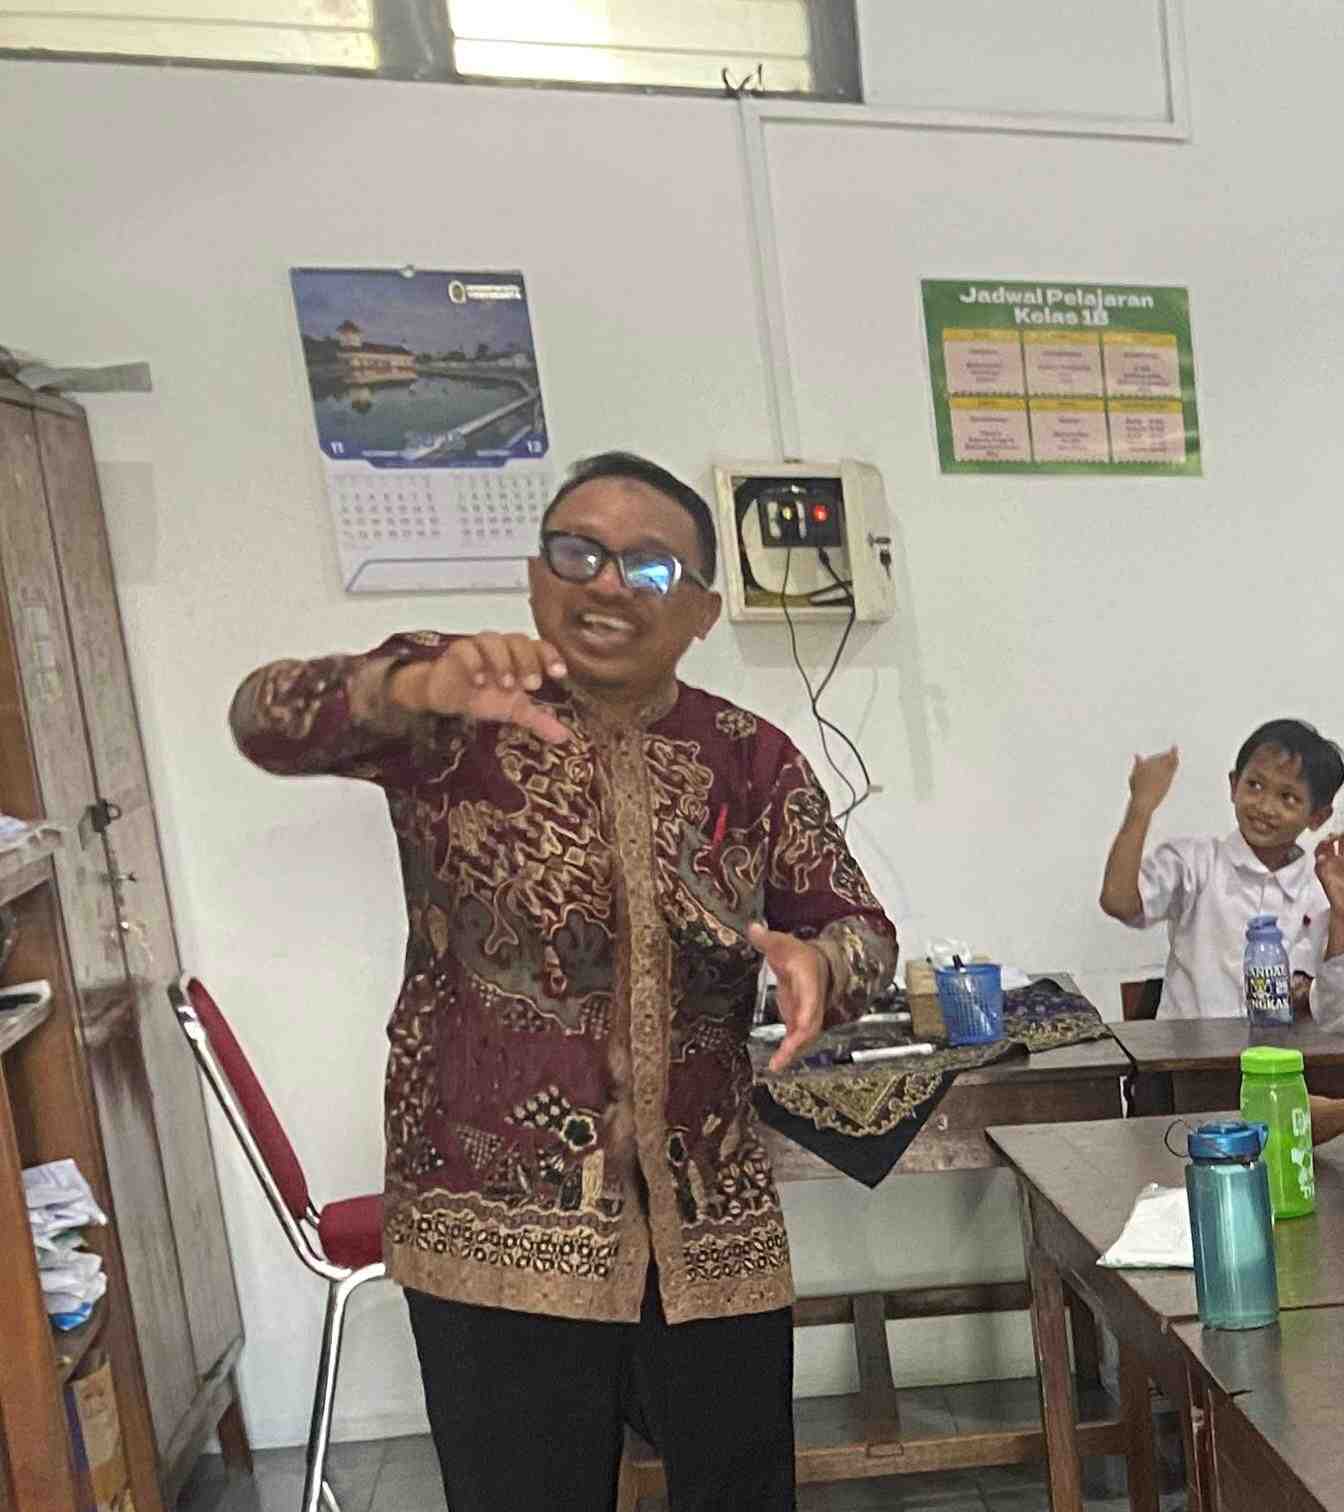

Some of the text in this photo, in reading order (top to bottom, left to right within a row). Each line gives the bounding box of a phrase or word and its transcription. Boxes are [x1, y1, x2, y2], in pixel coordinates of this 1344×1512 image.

[960, 287, 1154, 310] Jadwal Pelajaran
[1014, 306, 1078, 325] Kelas
